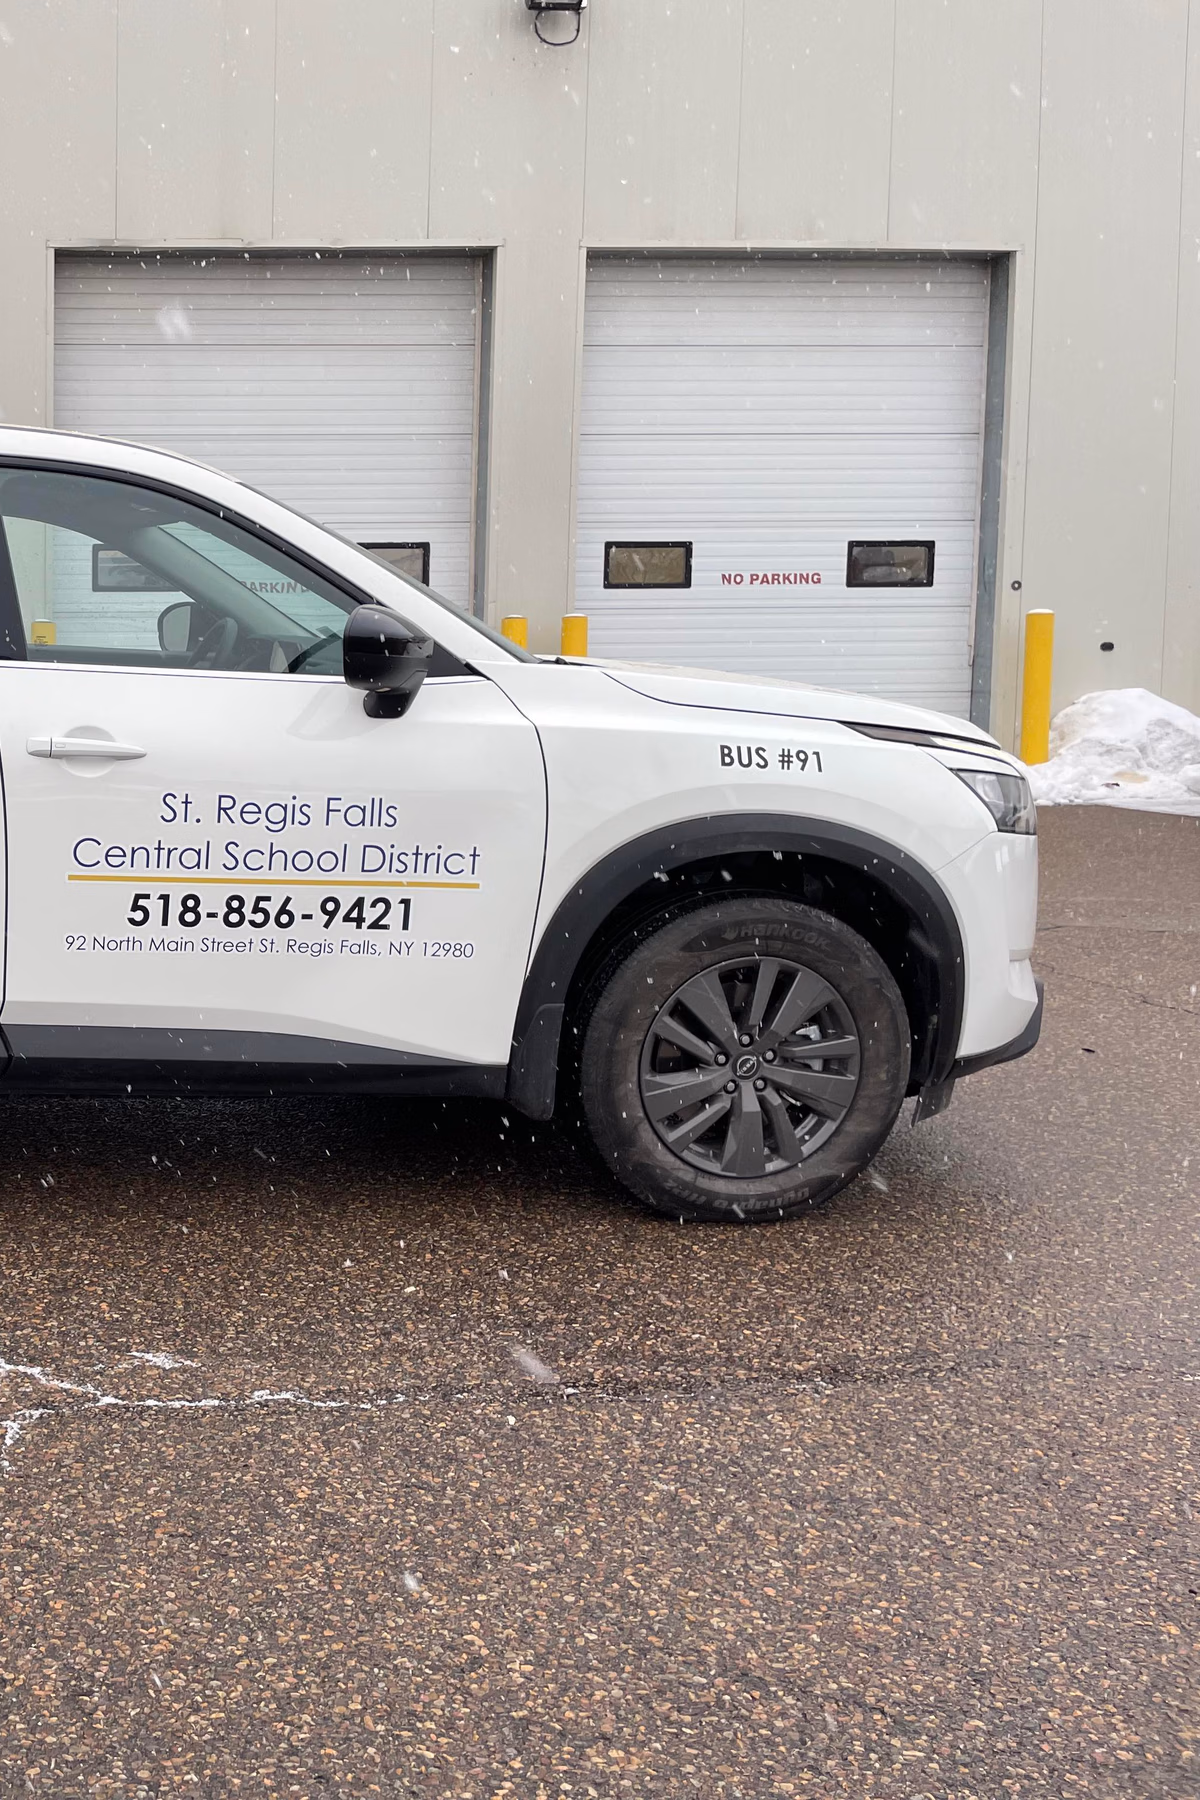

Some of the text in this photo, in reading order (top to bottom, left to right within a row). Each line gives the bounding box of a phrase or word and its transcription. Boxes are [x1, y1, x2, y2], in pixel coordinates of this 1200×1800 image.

[721, 572, 822, 585] NO PARKING
[719, 744, 823, 773] BUS #91
[159, 792, 398, 833] St. Regis Falls
[72, 837, 481, 876] Central School District
[126, 893, 412, 931] 518-856-9421
[64, 935, 475, 959] 92 North Main Street St. Regis Falls, NY 12980
